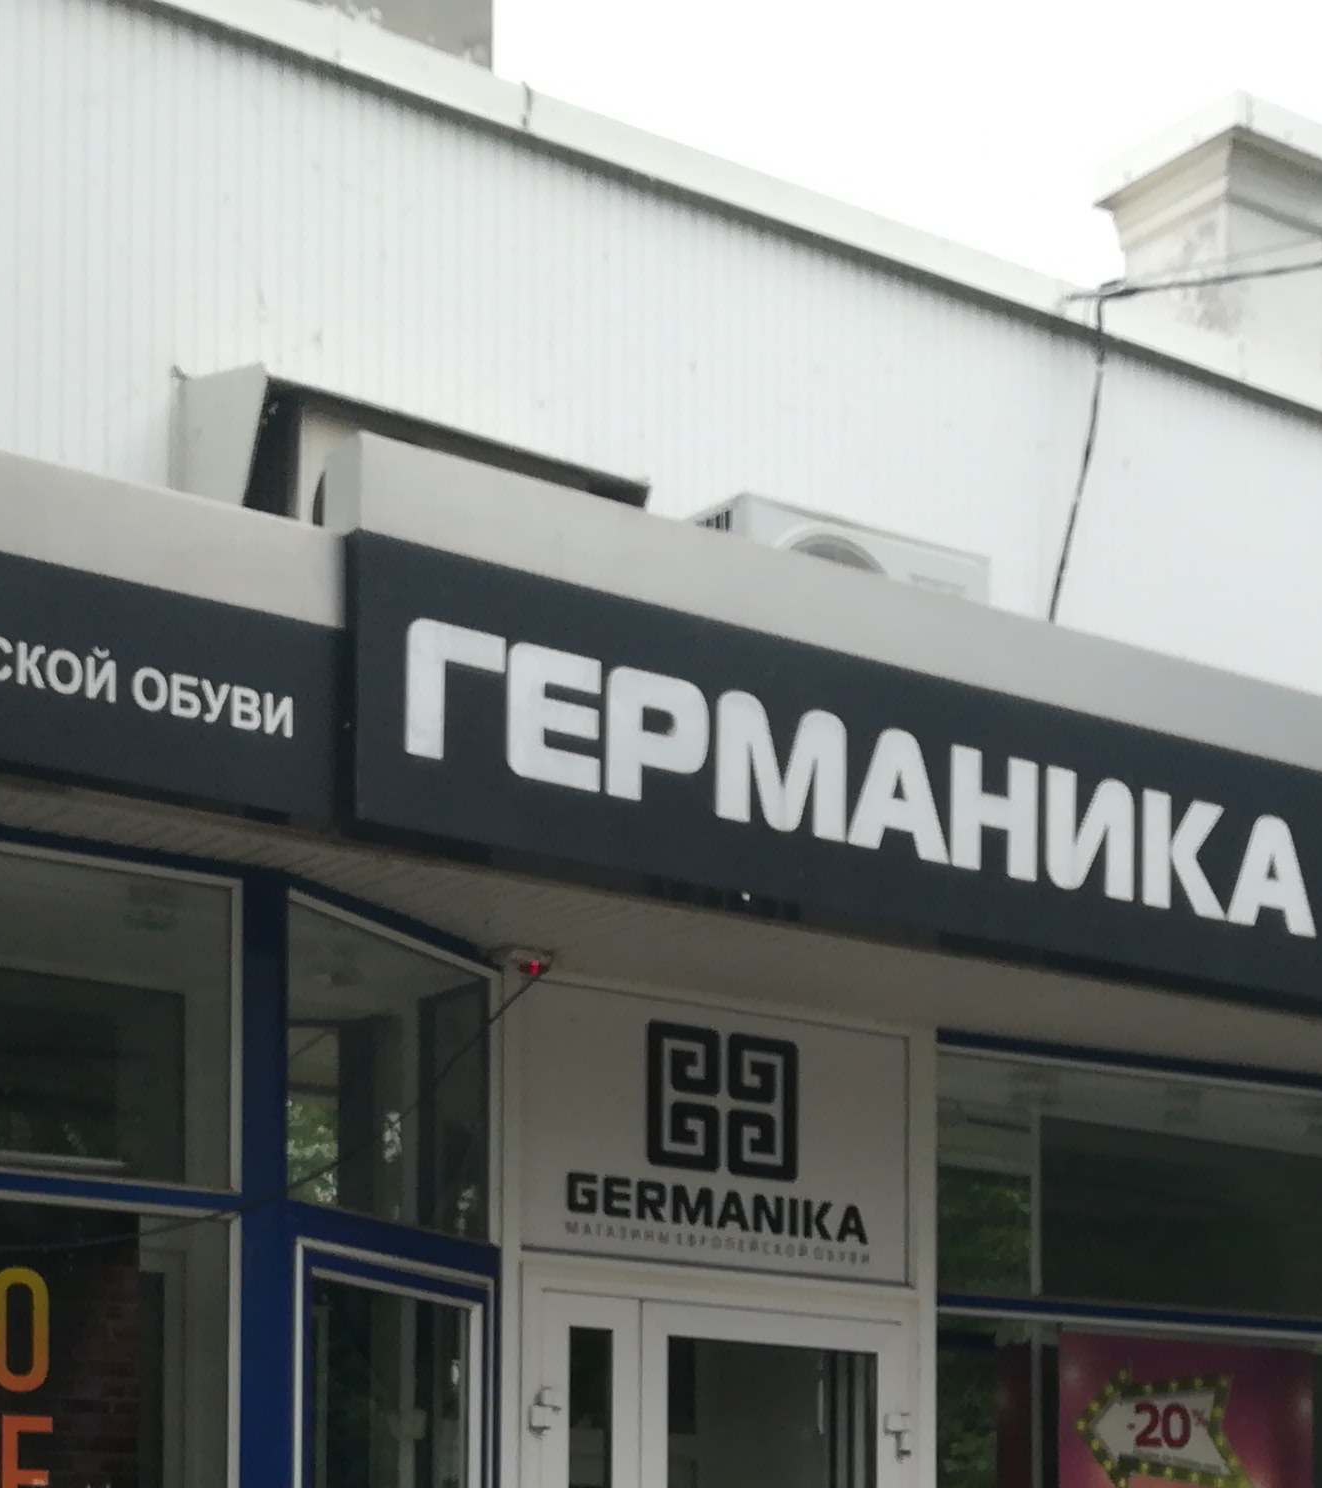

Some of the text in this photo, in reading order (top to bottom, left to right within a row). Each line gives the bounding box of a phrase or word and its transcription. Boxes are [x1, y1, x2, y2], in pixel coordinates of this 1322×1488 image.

[132, 665, 295, 739] ОБУВИ
[403, 617, 1318, 938] ГЕРМАНИКА
[564, 1170, 869, 1246] GERMANIKA
